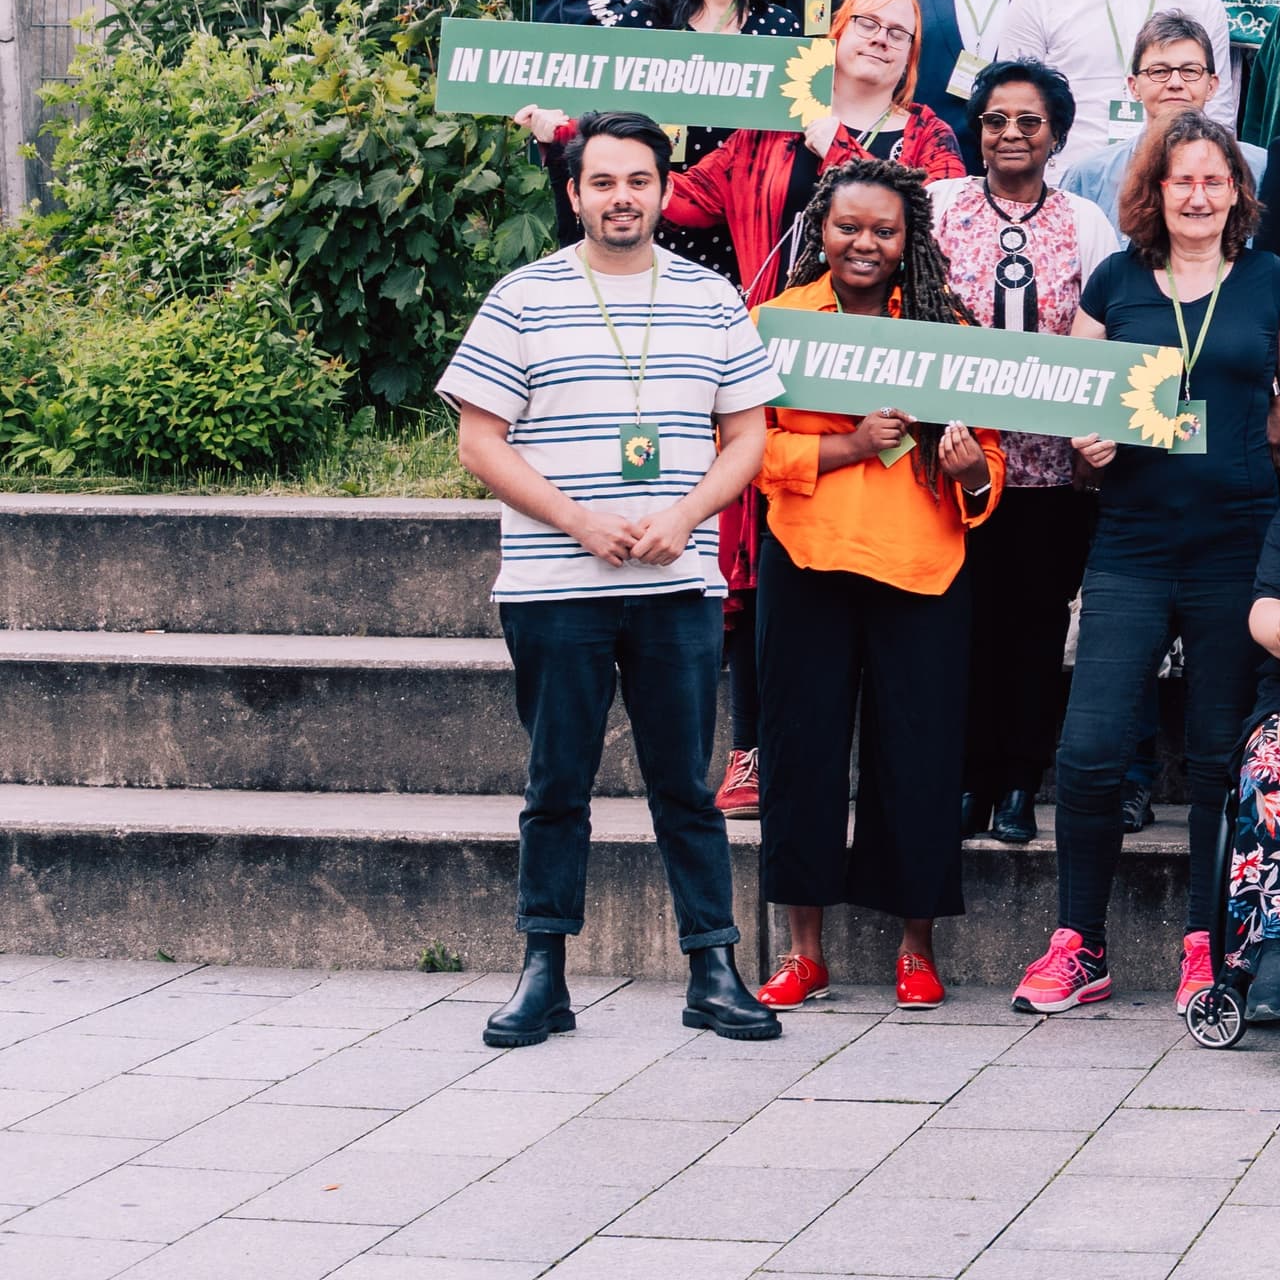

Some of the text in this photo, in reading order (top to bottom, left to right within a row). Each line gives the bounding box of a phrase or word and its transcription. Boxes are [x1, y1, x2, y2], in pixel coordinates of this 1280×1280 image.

[447, 47, 775, 99] IN VIELFALT VERBÜNDET
[765, 337, 1116, 407] IN VIELFALT VERBÜNDET
